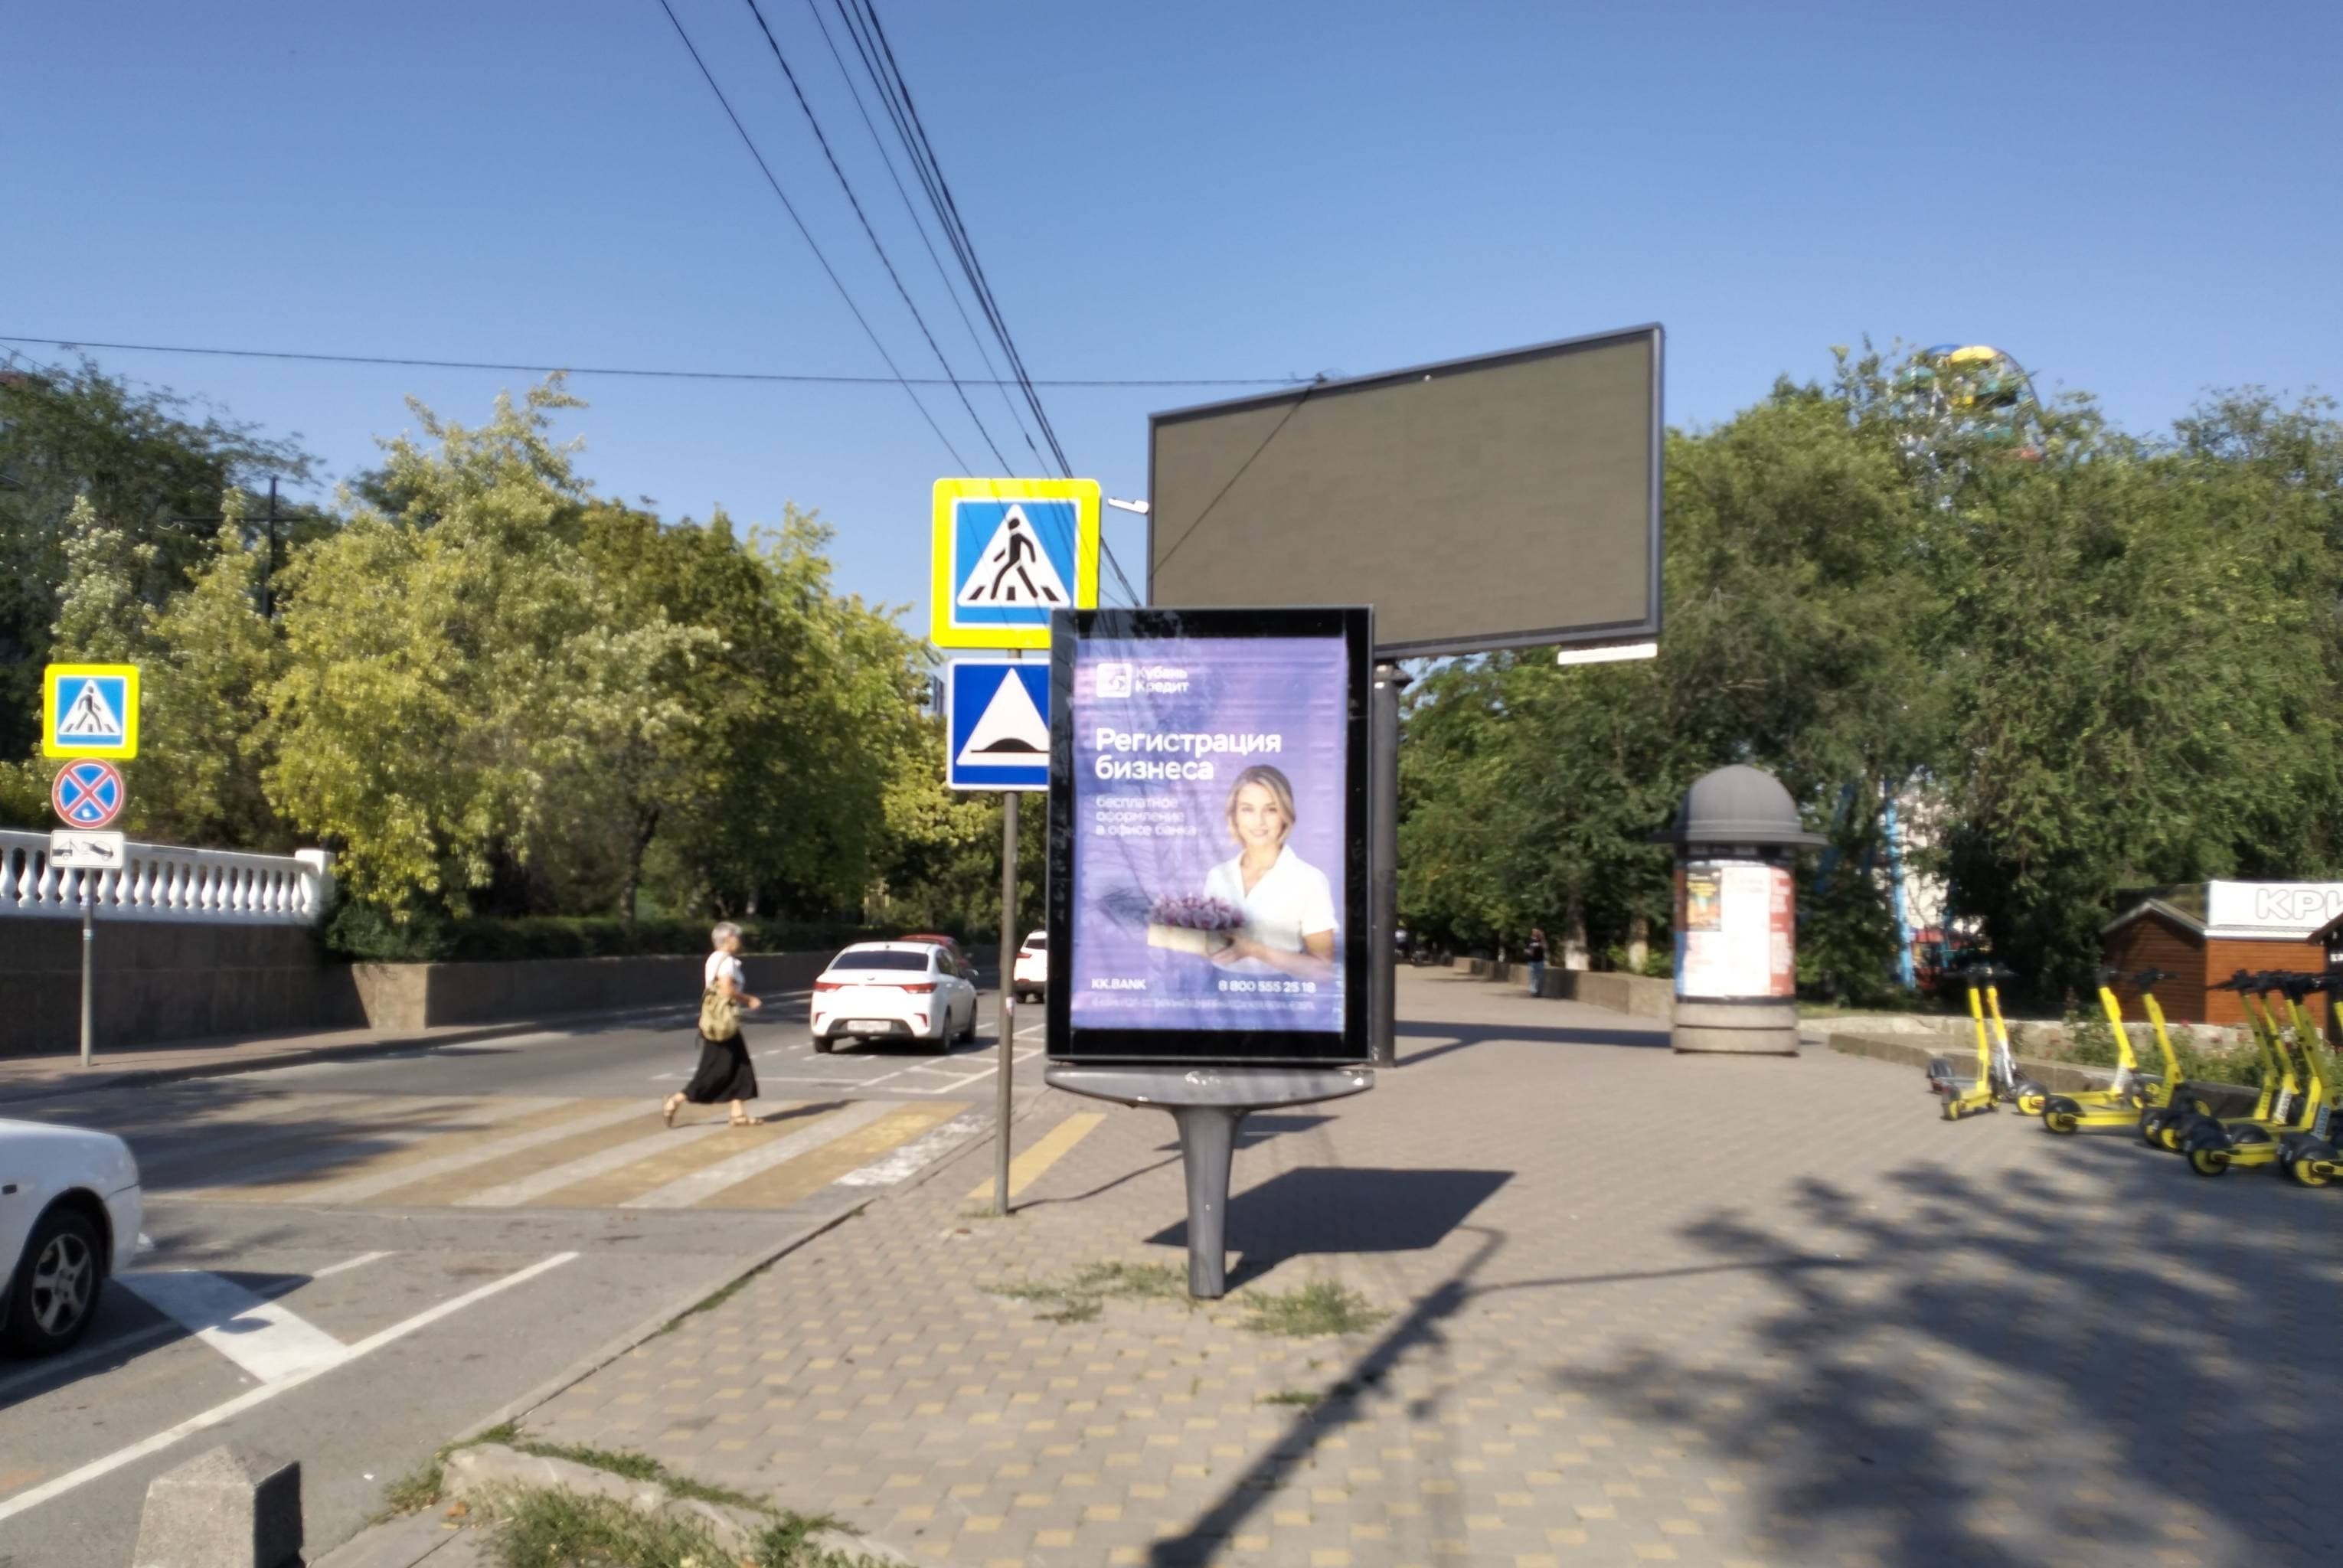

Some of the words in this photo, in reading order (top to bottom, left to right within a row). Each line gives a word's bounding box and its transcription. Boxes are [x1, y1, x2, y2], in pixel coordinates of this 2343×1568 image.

[1136, 680, 1189, 694] Кредит
[1096, 727, 1282, 759] Регистрация
[1095, 754, 1214, 779] бизнеса
[1091, 978, 1147, 990] KK.BANK
[1230, 980, 1256, 992] 800
[1258, 981, 1282, 993] 555
